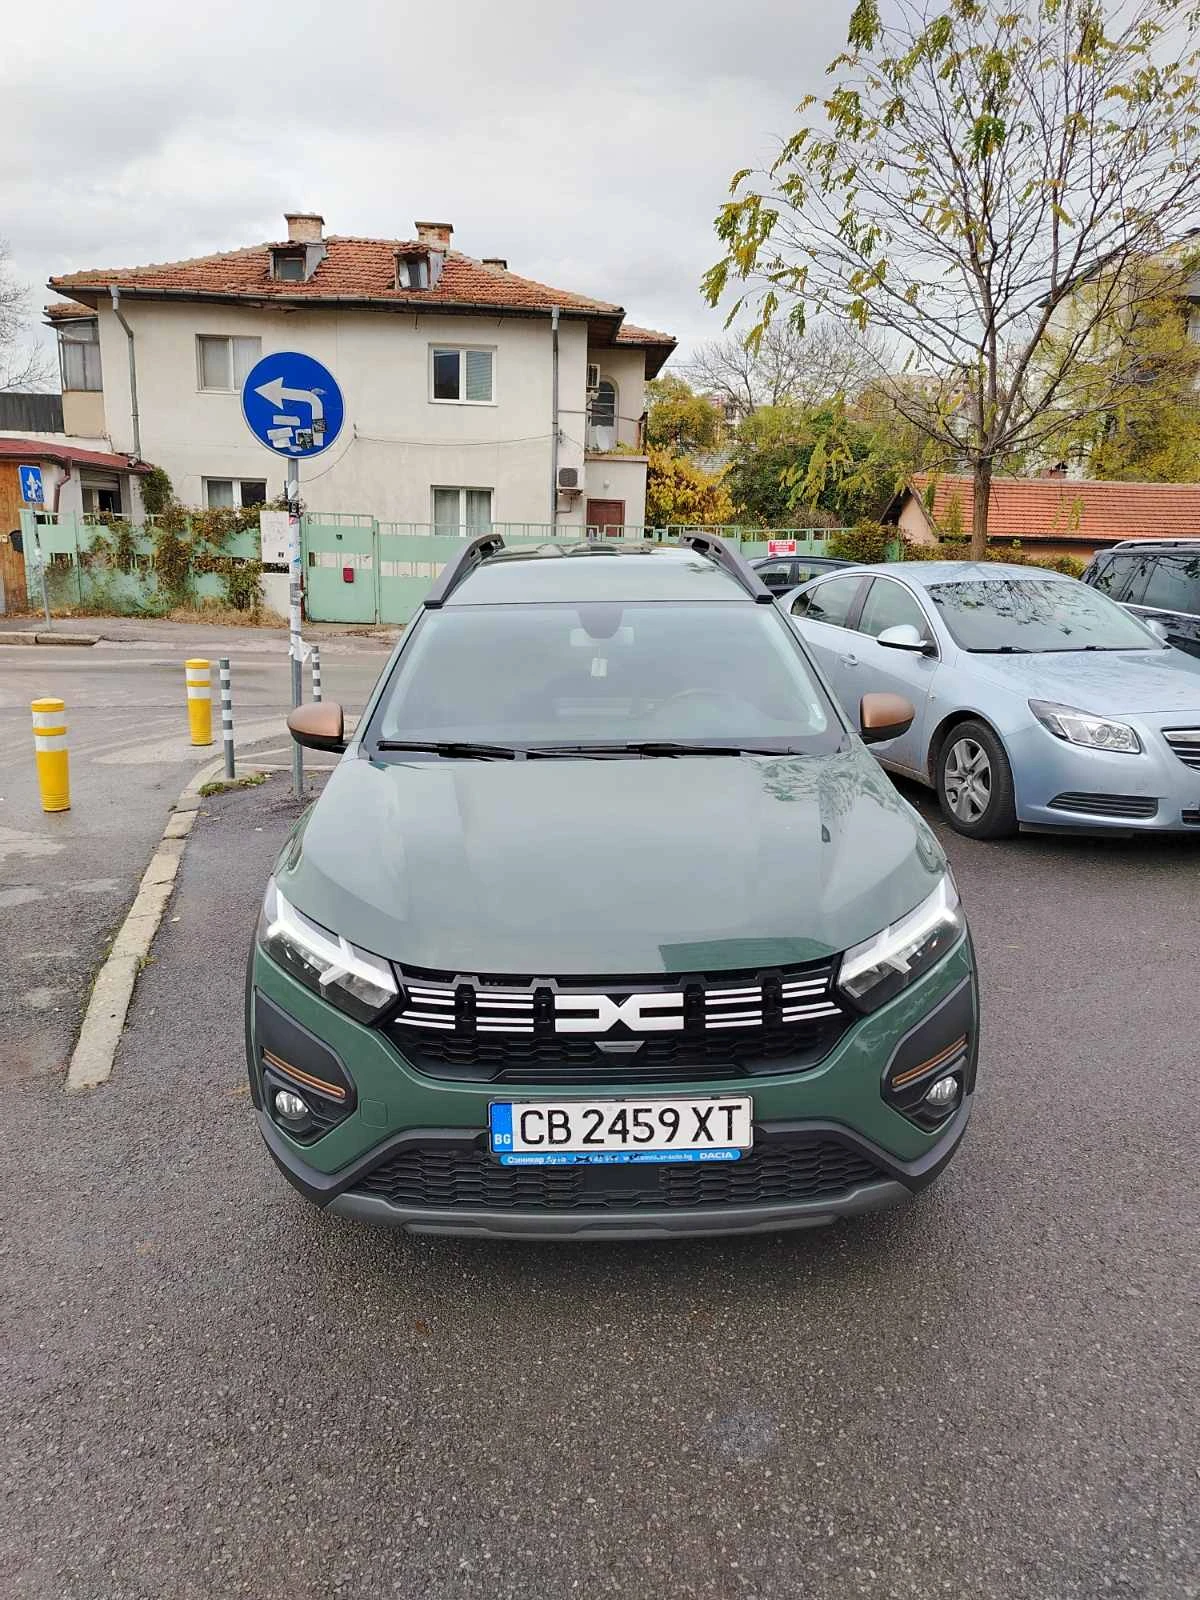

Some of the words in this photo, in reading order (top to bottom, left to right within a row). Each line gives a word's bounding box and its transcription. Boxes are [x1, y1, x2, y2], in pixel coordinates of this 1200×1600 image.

[520, 1109, 572, 1145] CB
[582, 1106, 681, 1144] 2459
[691, 1104, 743, 1142] XT
[494, 1134, 511, 1145] BG
[699, 1151, 733, 1160] DACIA
